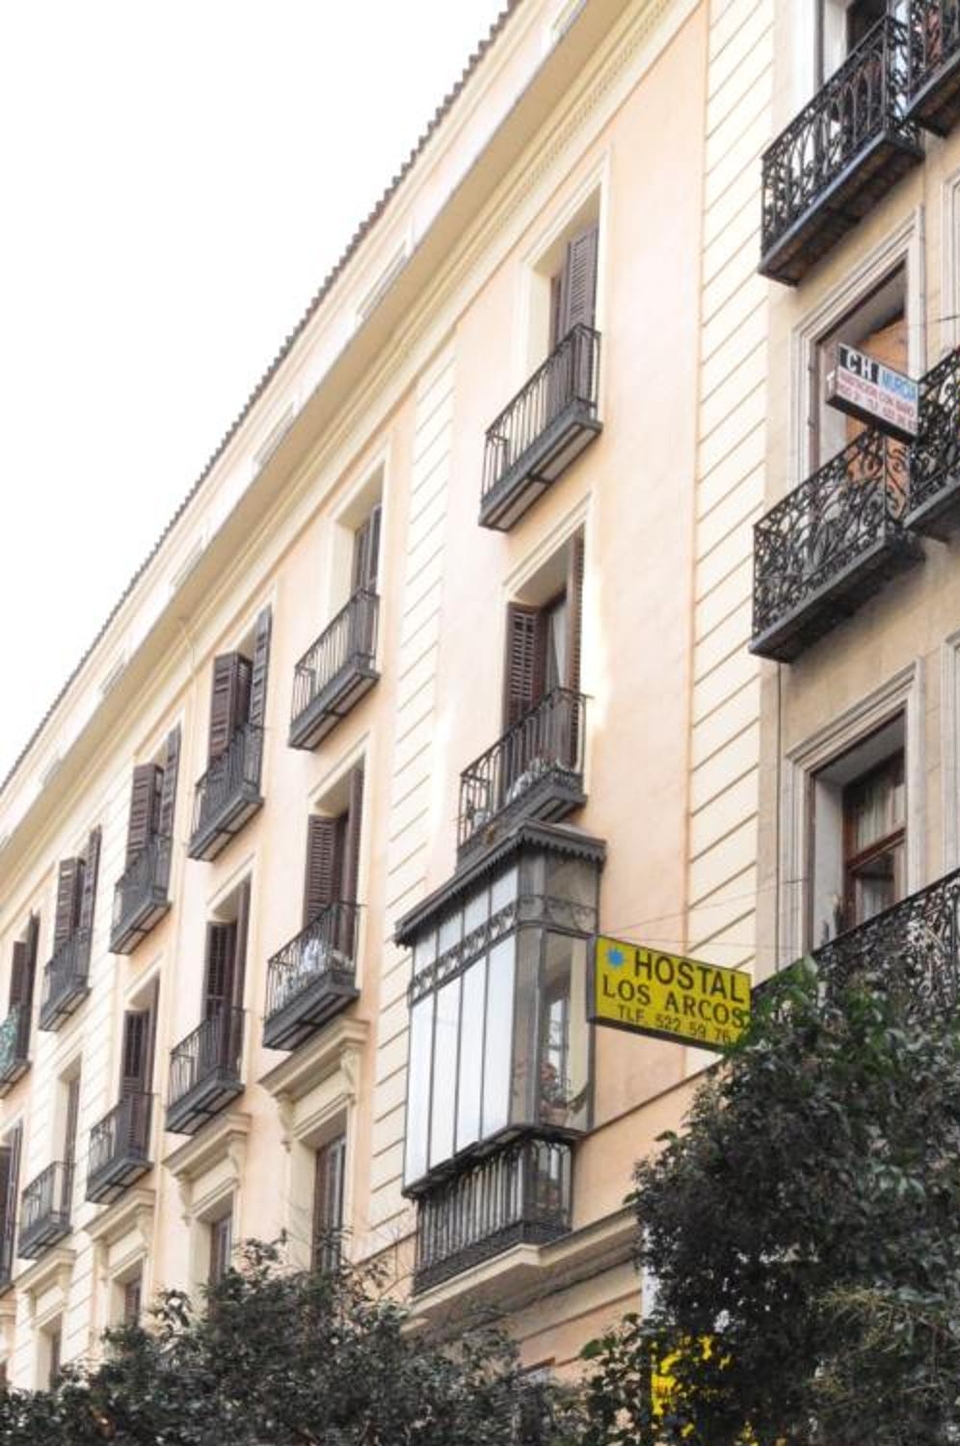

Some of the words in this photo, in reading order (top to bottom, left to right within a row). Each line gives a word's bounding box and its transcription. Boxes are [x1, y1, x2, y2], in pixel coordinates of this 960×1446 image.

[603, 974, 651, 1006] LOS
[664, 991, 747, 1029] ARCOS
[635, 951, 745, 1004] HOSTAL
